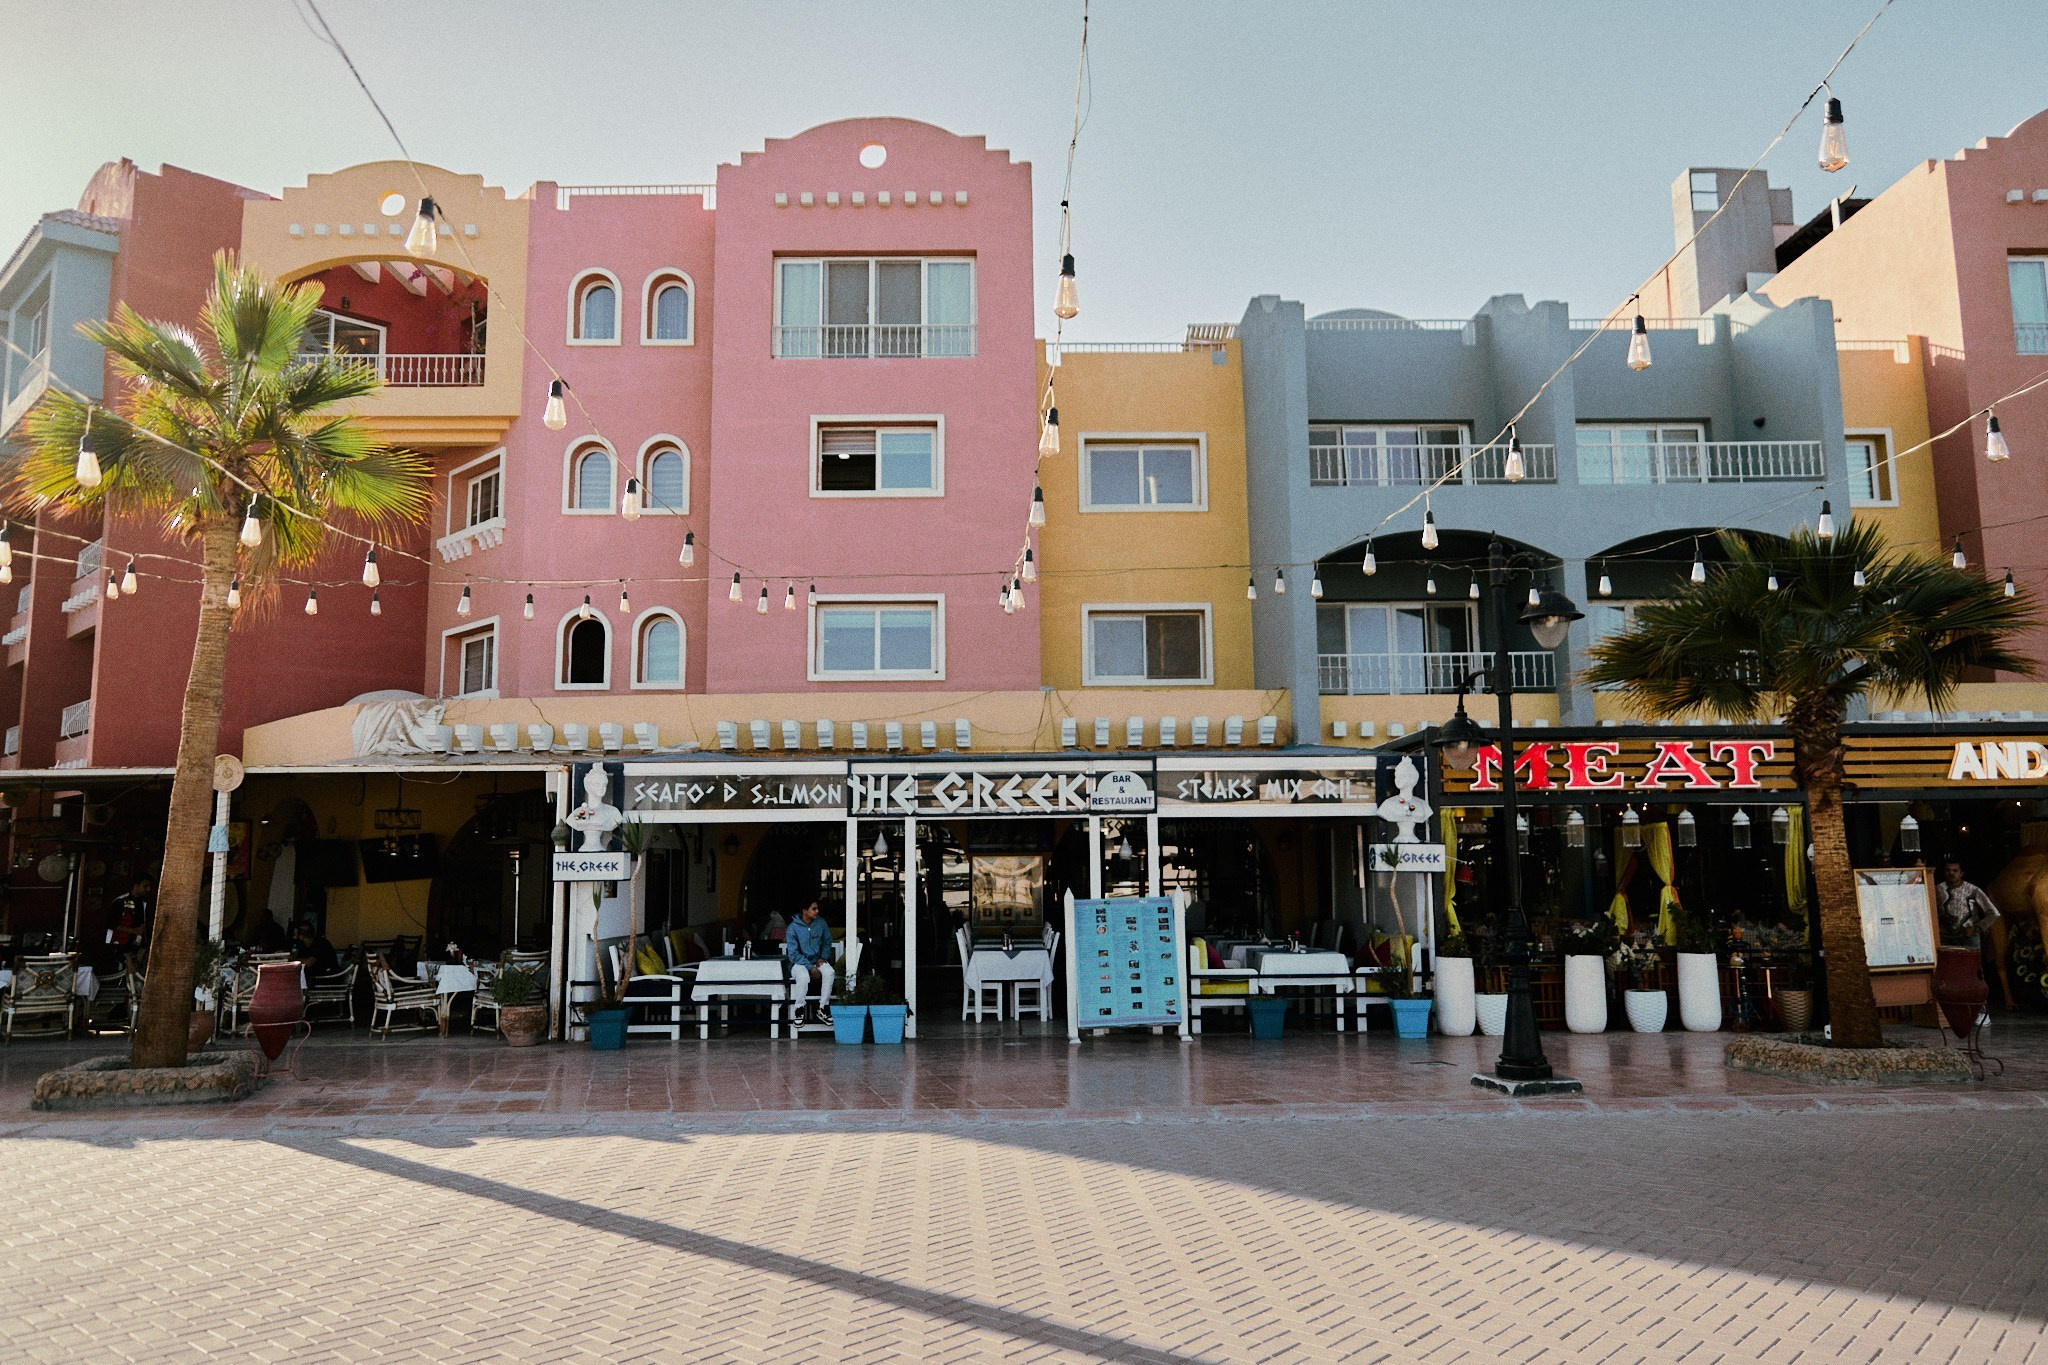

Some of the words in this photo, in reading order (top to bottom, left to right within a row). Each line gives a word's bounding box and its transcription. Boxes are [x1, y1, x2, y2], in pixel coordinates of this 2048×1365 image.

[1470, 740, 1775, 791] MEAT
[1947, 741, 2048, 781] AND
[1112, 774, 1131, 784] BAR
[847, 773, 916, 815] THE
[931, 770, 1088, 814] GREEK
[1118, 786, 1125, 794] &
[1176, 778, 1253, 800] STEAKS
[1264, 778, 1304, 800] MIX
[1092, 796, 1154, 806] RESTAURANT
